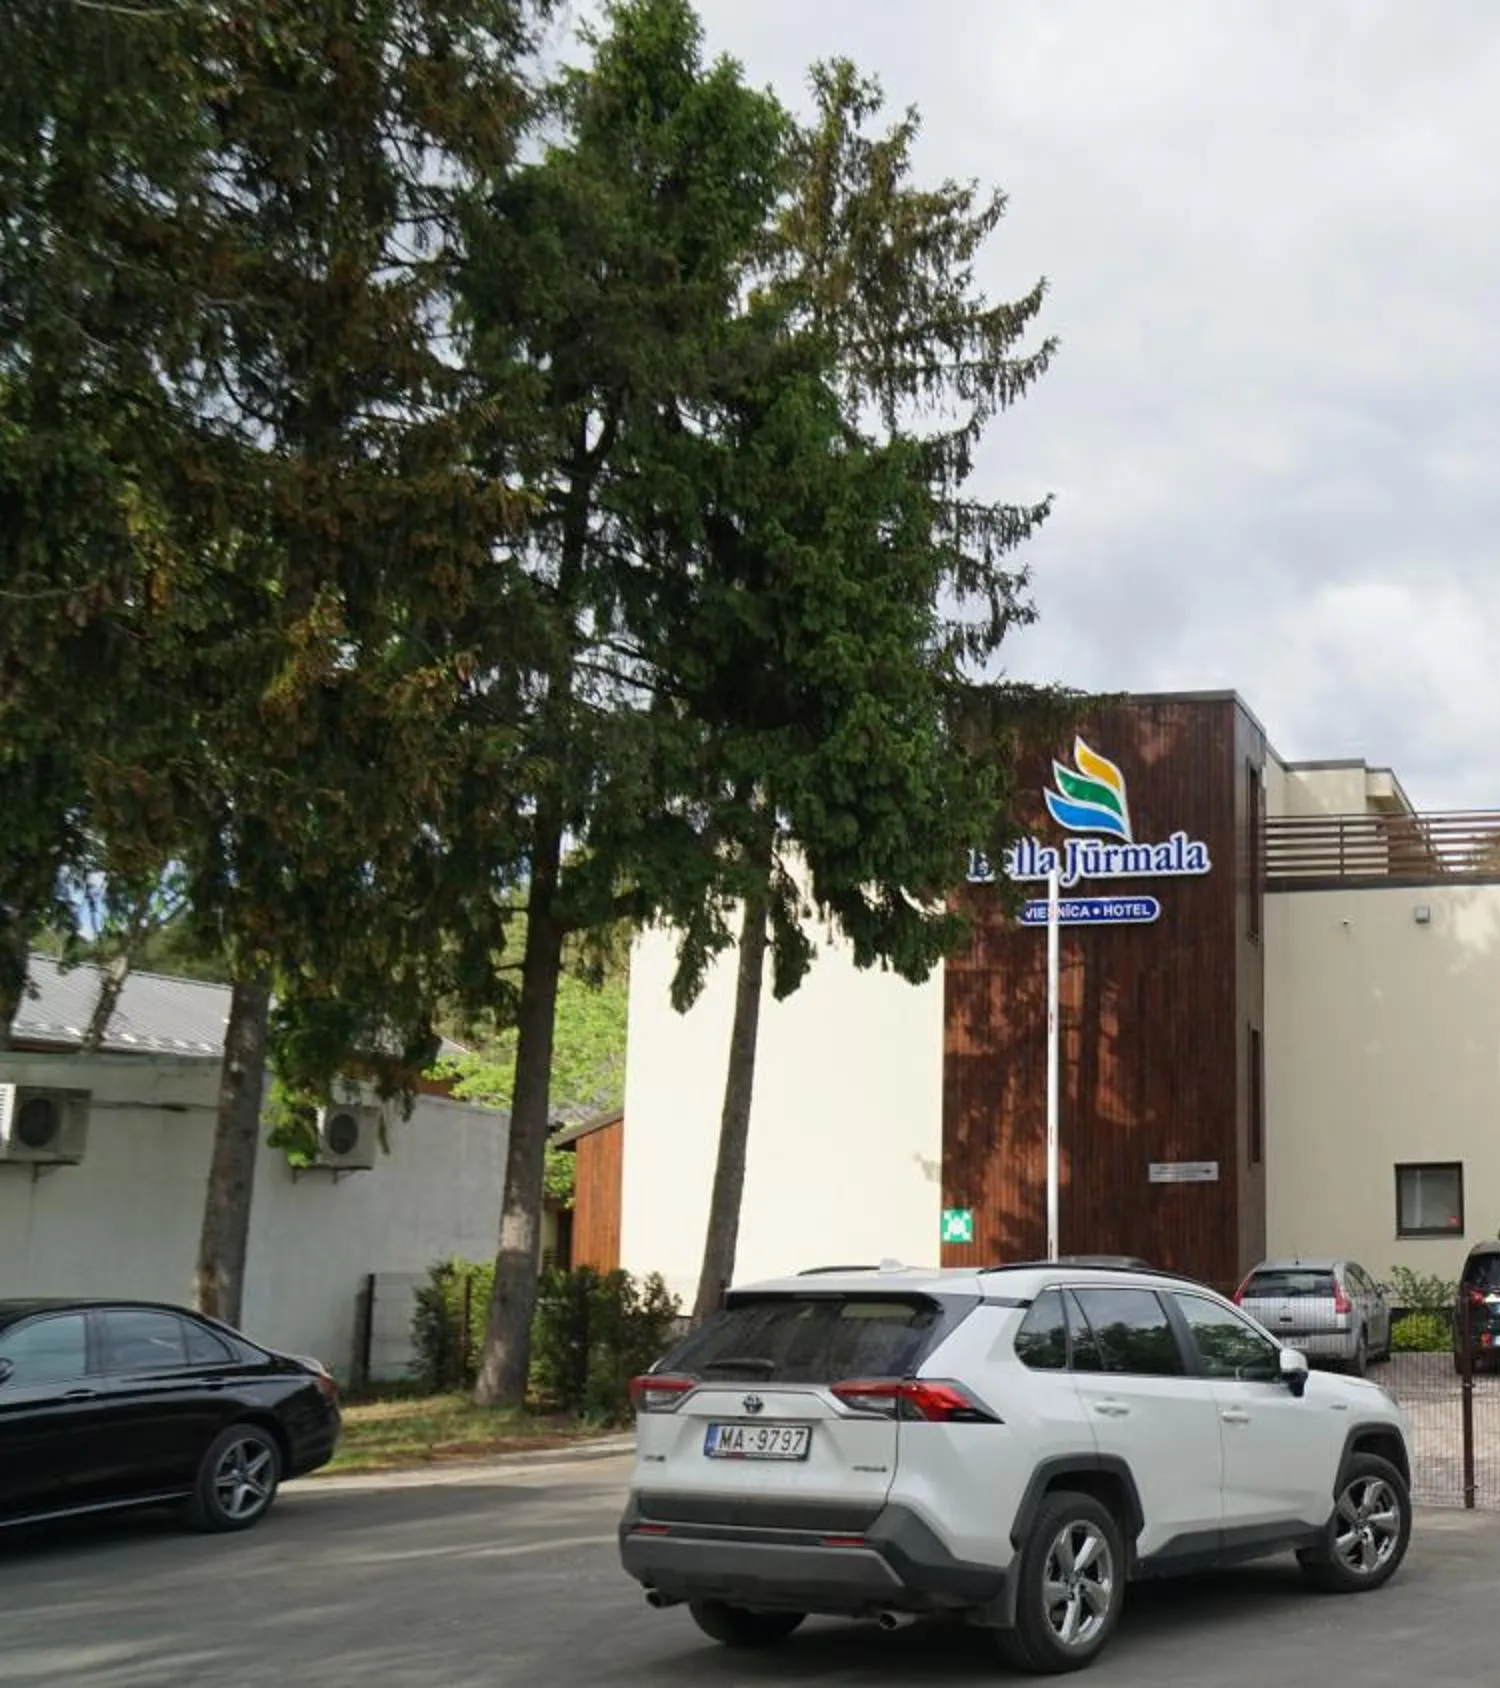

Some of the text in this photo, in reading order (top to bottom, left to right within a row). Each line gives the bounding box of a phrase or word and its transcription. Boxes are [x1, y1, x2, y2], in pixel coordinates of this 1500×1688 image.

[1062, 835, 1207, 884] Jūrmala
[1025, 903, 1151, 919] VIENĪCA HOTEL
[720, 1428, 805, 1452] MA-9797
